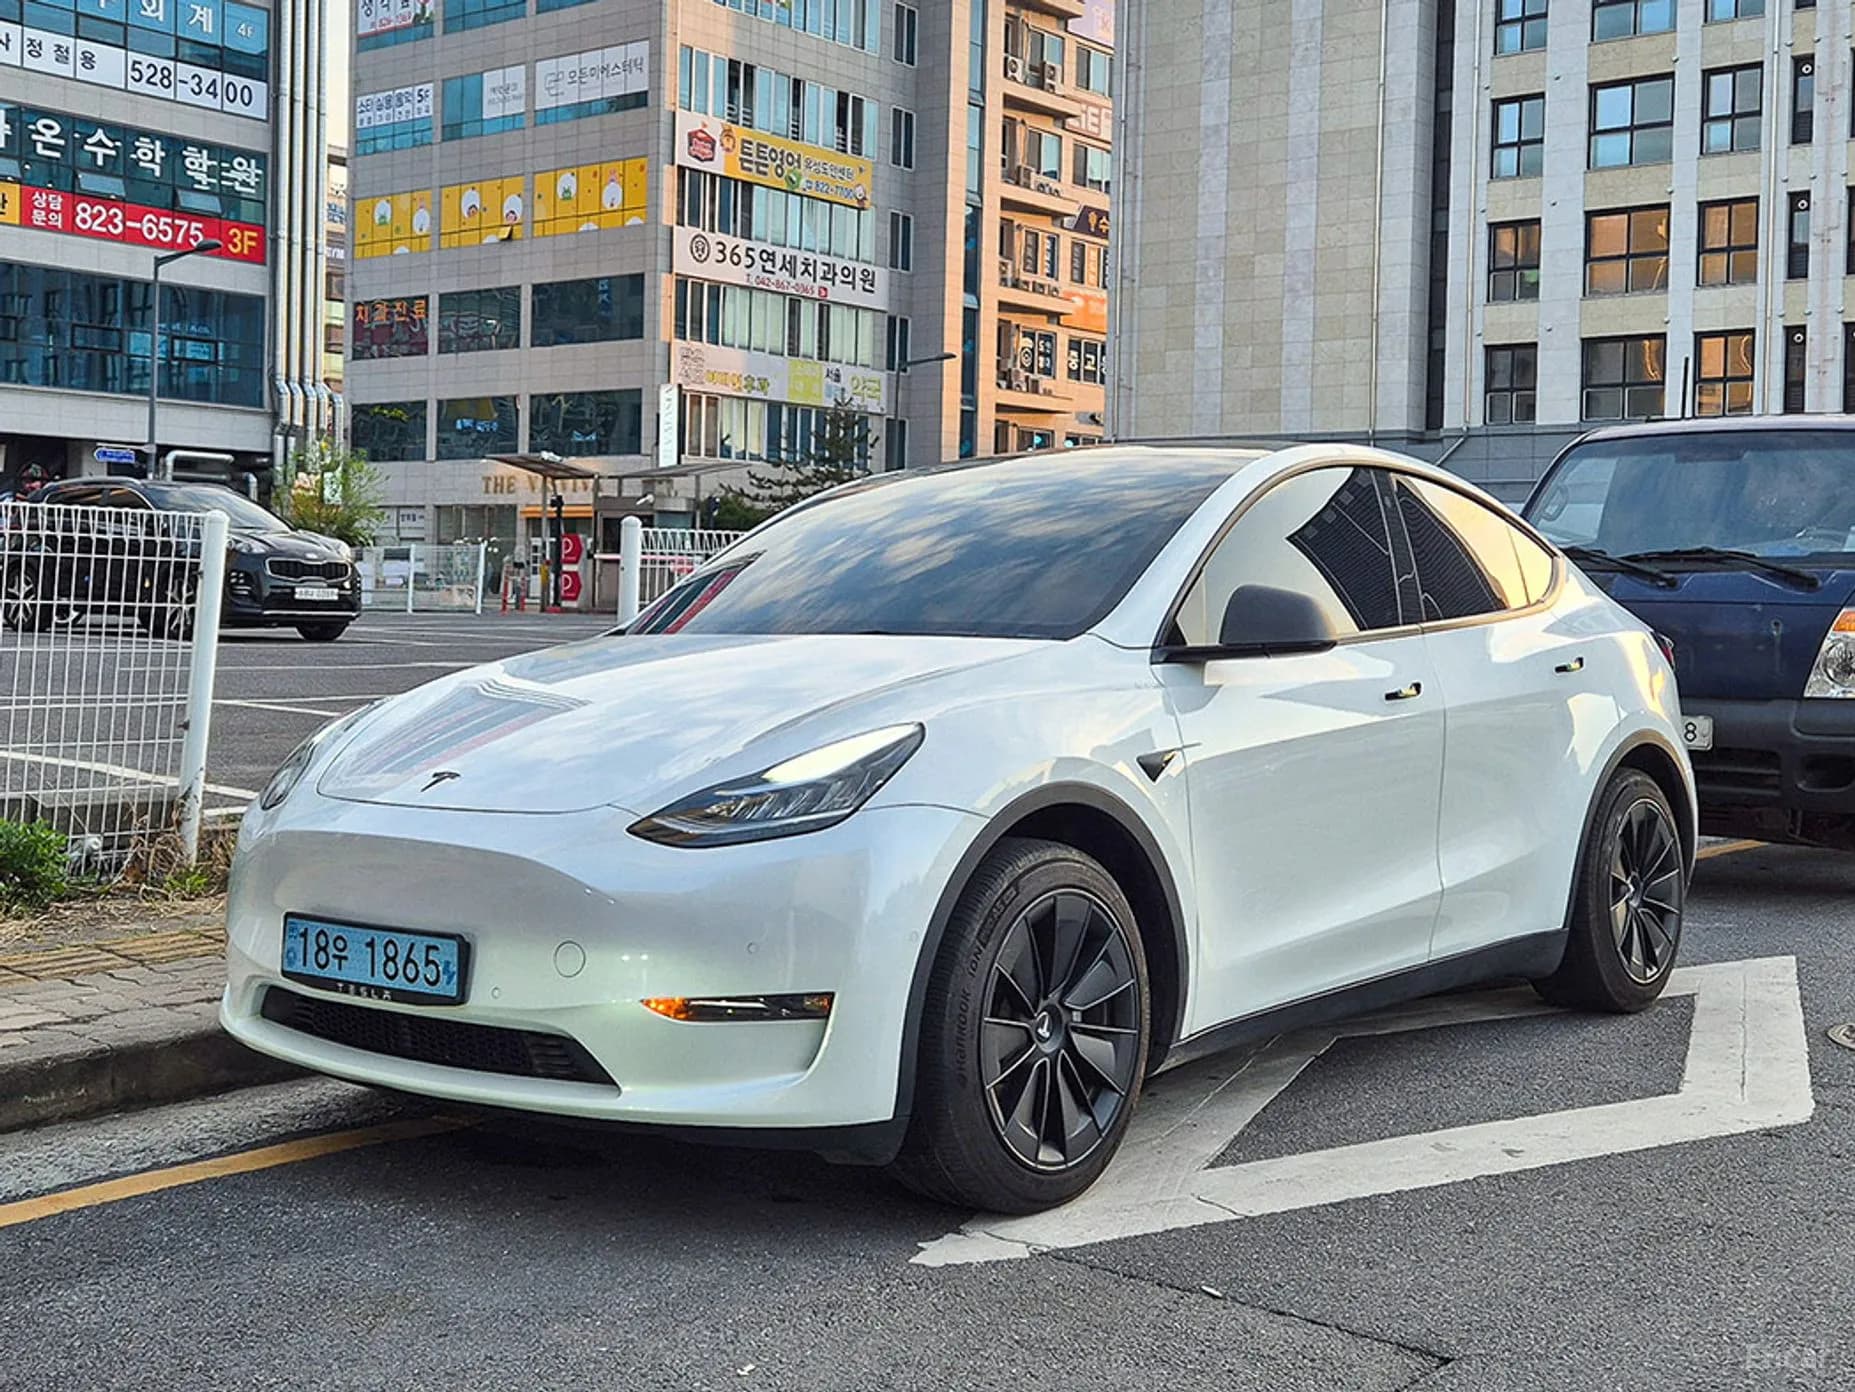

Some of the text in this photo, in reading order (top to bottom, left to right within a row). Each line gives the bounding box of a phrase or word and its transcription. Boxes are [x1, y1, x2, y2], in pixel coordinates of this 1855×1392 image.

[237, 23, 254, 38] 4F
[130, 60, 253, 107] 528-3400
[739, 137, 802, 178] 튼튼영어
[32, 191, 63, 210] 상담
[32, 209, 62, 229] 문의
[75, 202, 259, 254] 823-6575 3F
[715, 241, 876, 294] 365연세치과의원
[482, 475, 516, 494] THE
[299, 927, 349, 971] 18우
[365, 936, 441, 987] 1865
[336, 982, 392, 1001] TESLA
